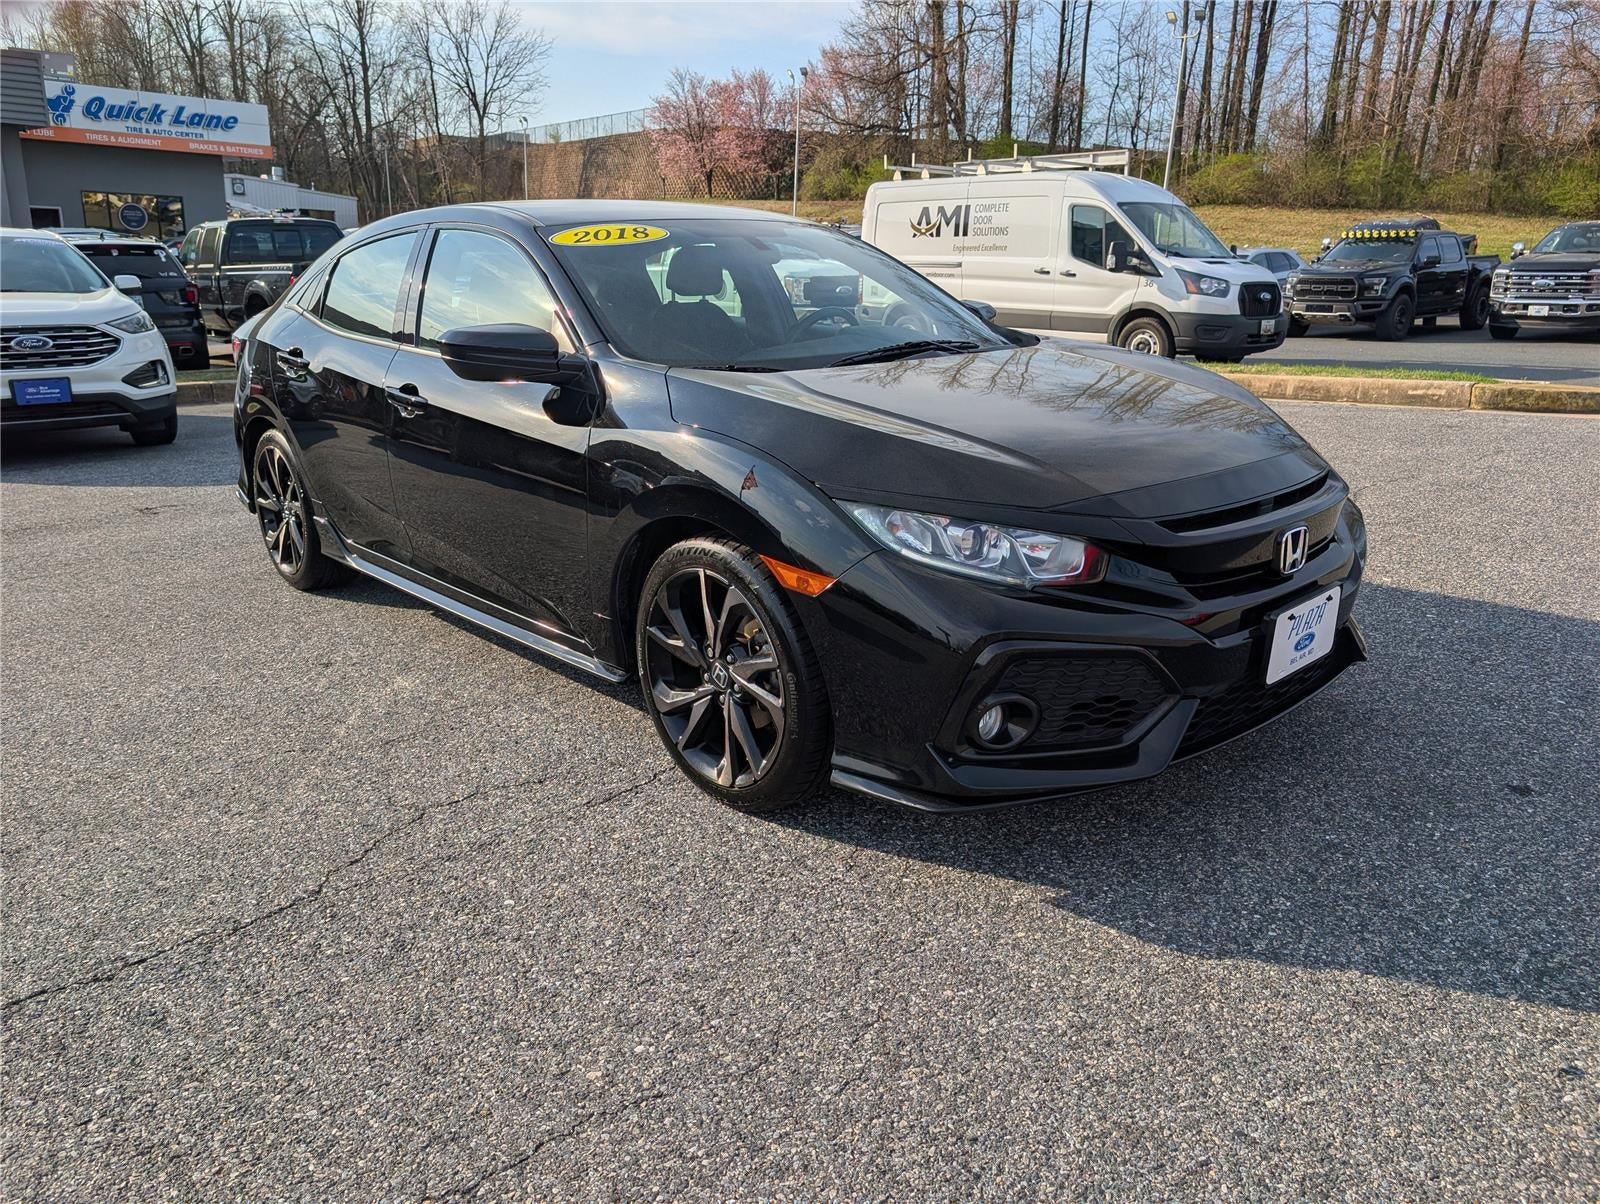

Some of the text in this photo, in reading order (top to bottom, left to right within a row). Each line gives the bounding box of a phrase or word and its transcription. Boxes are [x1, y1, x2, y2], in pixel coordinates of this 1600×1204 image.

[82, 95, 239, 132] Quick Lane
[33, 129, 55, 137] LUBE
[125, 126, 143, 134] TIRE
[152, 128, 173, 136] AUTO
[174, 131, 205, 139] CENTER
[85, 133, 109, 142] TIRES
[117, 136, 162, 147] ALIGNMENT
[189, 142, 219, 151] BRAKES
[226, 145, 264, 155] BATTERIES
[974, 203, 1010, 213] COMPLETE
[911, 204, 971, 238] AMI
[973, 215, 993, 224] DOOR
[573, 226, 650, 243] 2018
[972, 226, 1009, 237] SOLUTIONS
[952, 243, 1008, 254] Engineered Excellence
[1143, 279, 1154, 288] 36
[21, 340, 44, 348] Ford
[1287, 601, 1328, 641] PLAZA
